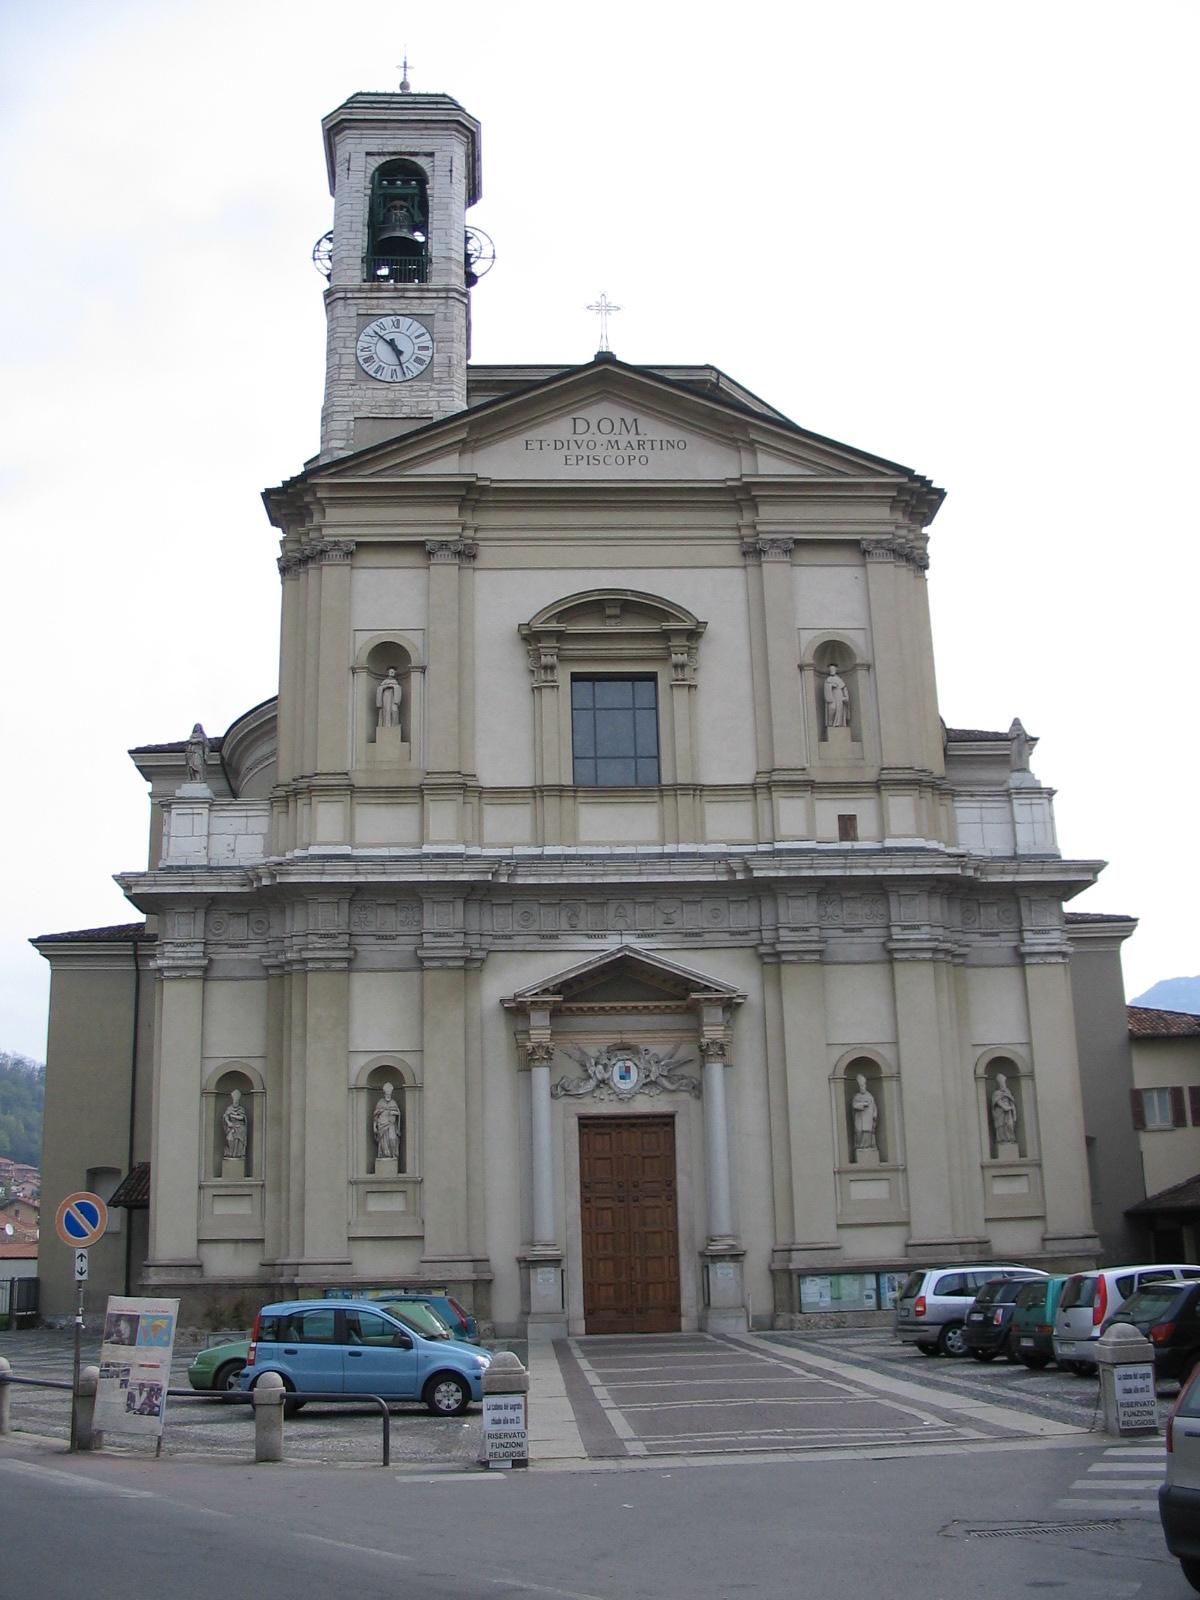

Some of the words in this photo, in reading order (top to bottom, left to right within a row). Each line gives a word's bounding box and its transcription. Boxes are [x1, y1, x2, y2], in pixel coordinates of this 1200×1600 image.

[563, 454, 649, 466] EPISCOPO
[1120, 1400, 1156, 1408] RISERVATO
[1123, 1409, 1154, 1418] FUNZIONI
[1122, 1418, 1157, 1427] RELIGIOSE
[487, 1431, 526, 1440] RISERVATO
[490, 1441, 524, 1450] FUNZIONI
[488, 1450, 527, 1459] RELIGIOSE
